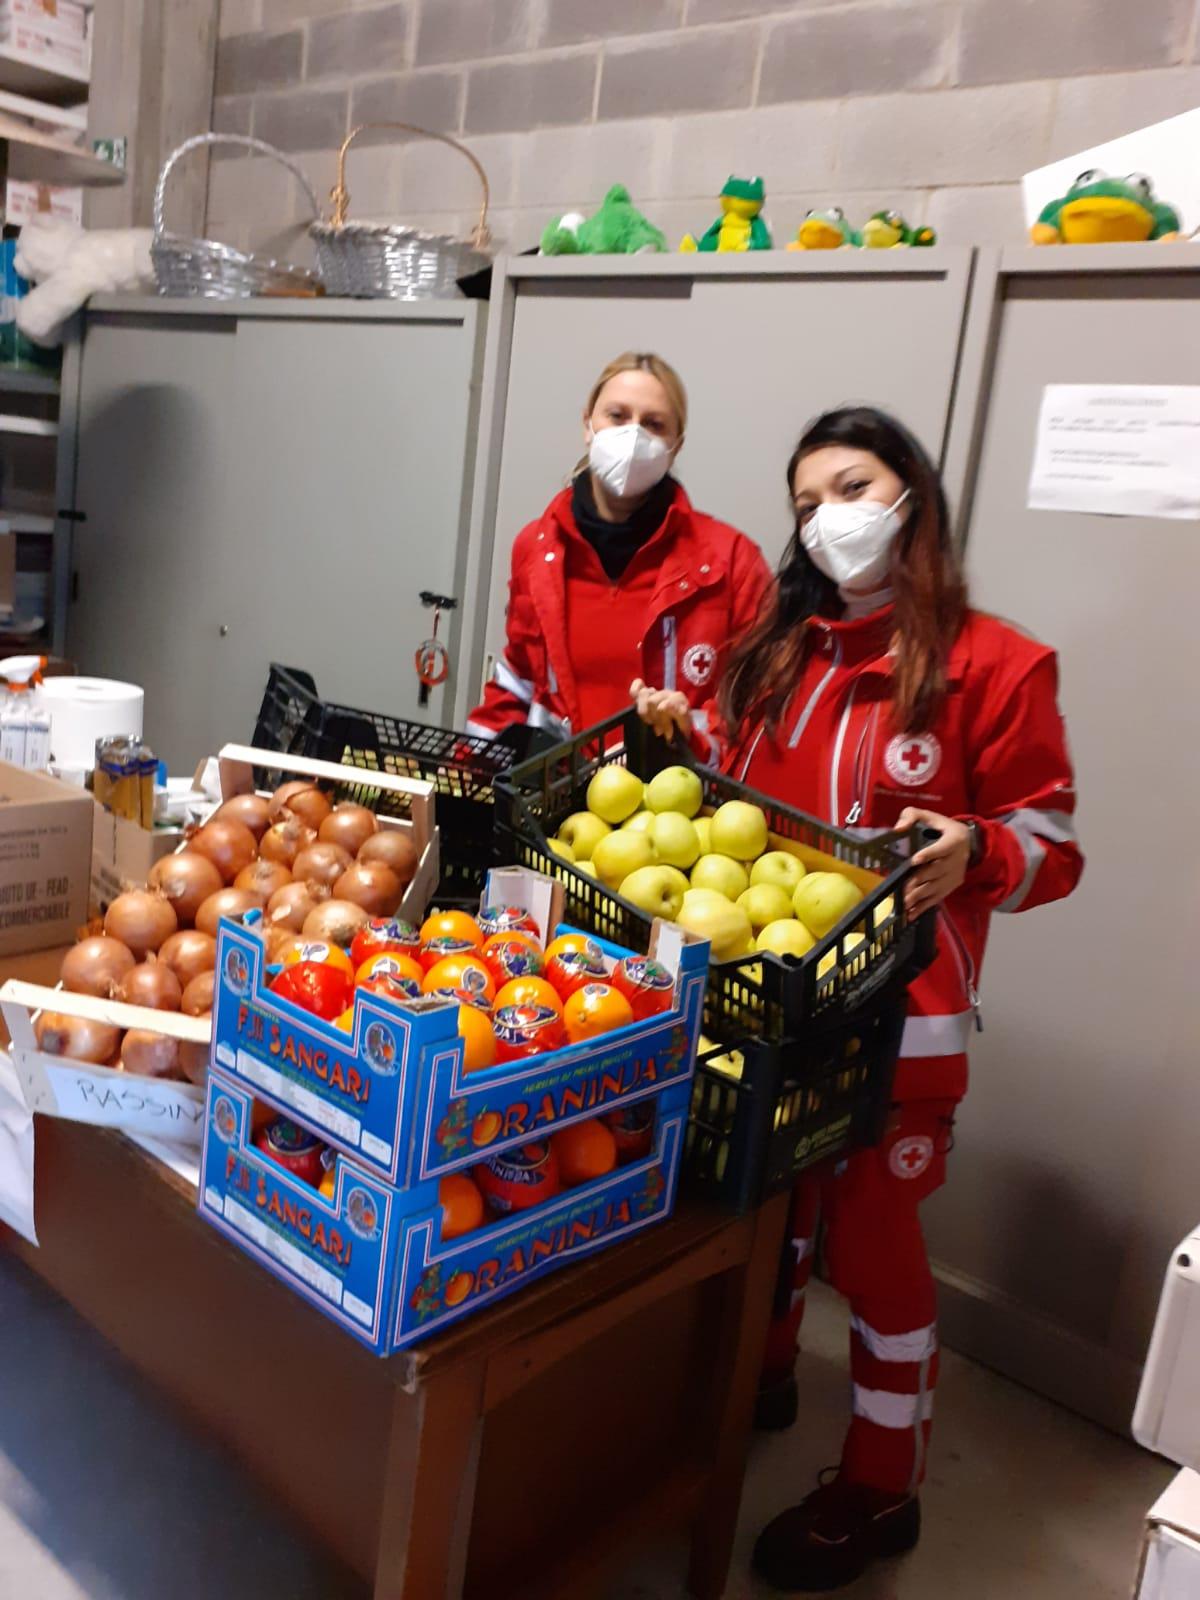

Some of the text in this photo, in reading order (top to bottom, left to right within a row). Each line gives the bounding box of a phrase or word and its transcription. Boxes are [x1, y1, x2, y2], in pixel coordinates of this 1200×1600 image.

[269, 1023, 371, 1104] SANGARI
[472, 1056, 657, 1147] ORANINJA
[255, 1175, 353, 1266] SANGARI
[443, 1198, 632, 1307] ORANINJA
